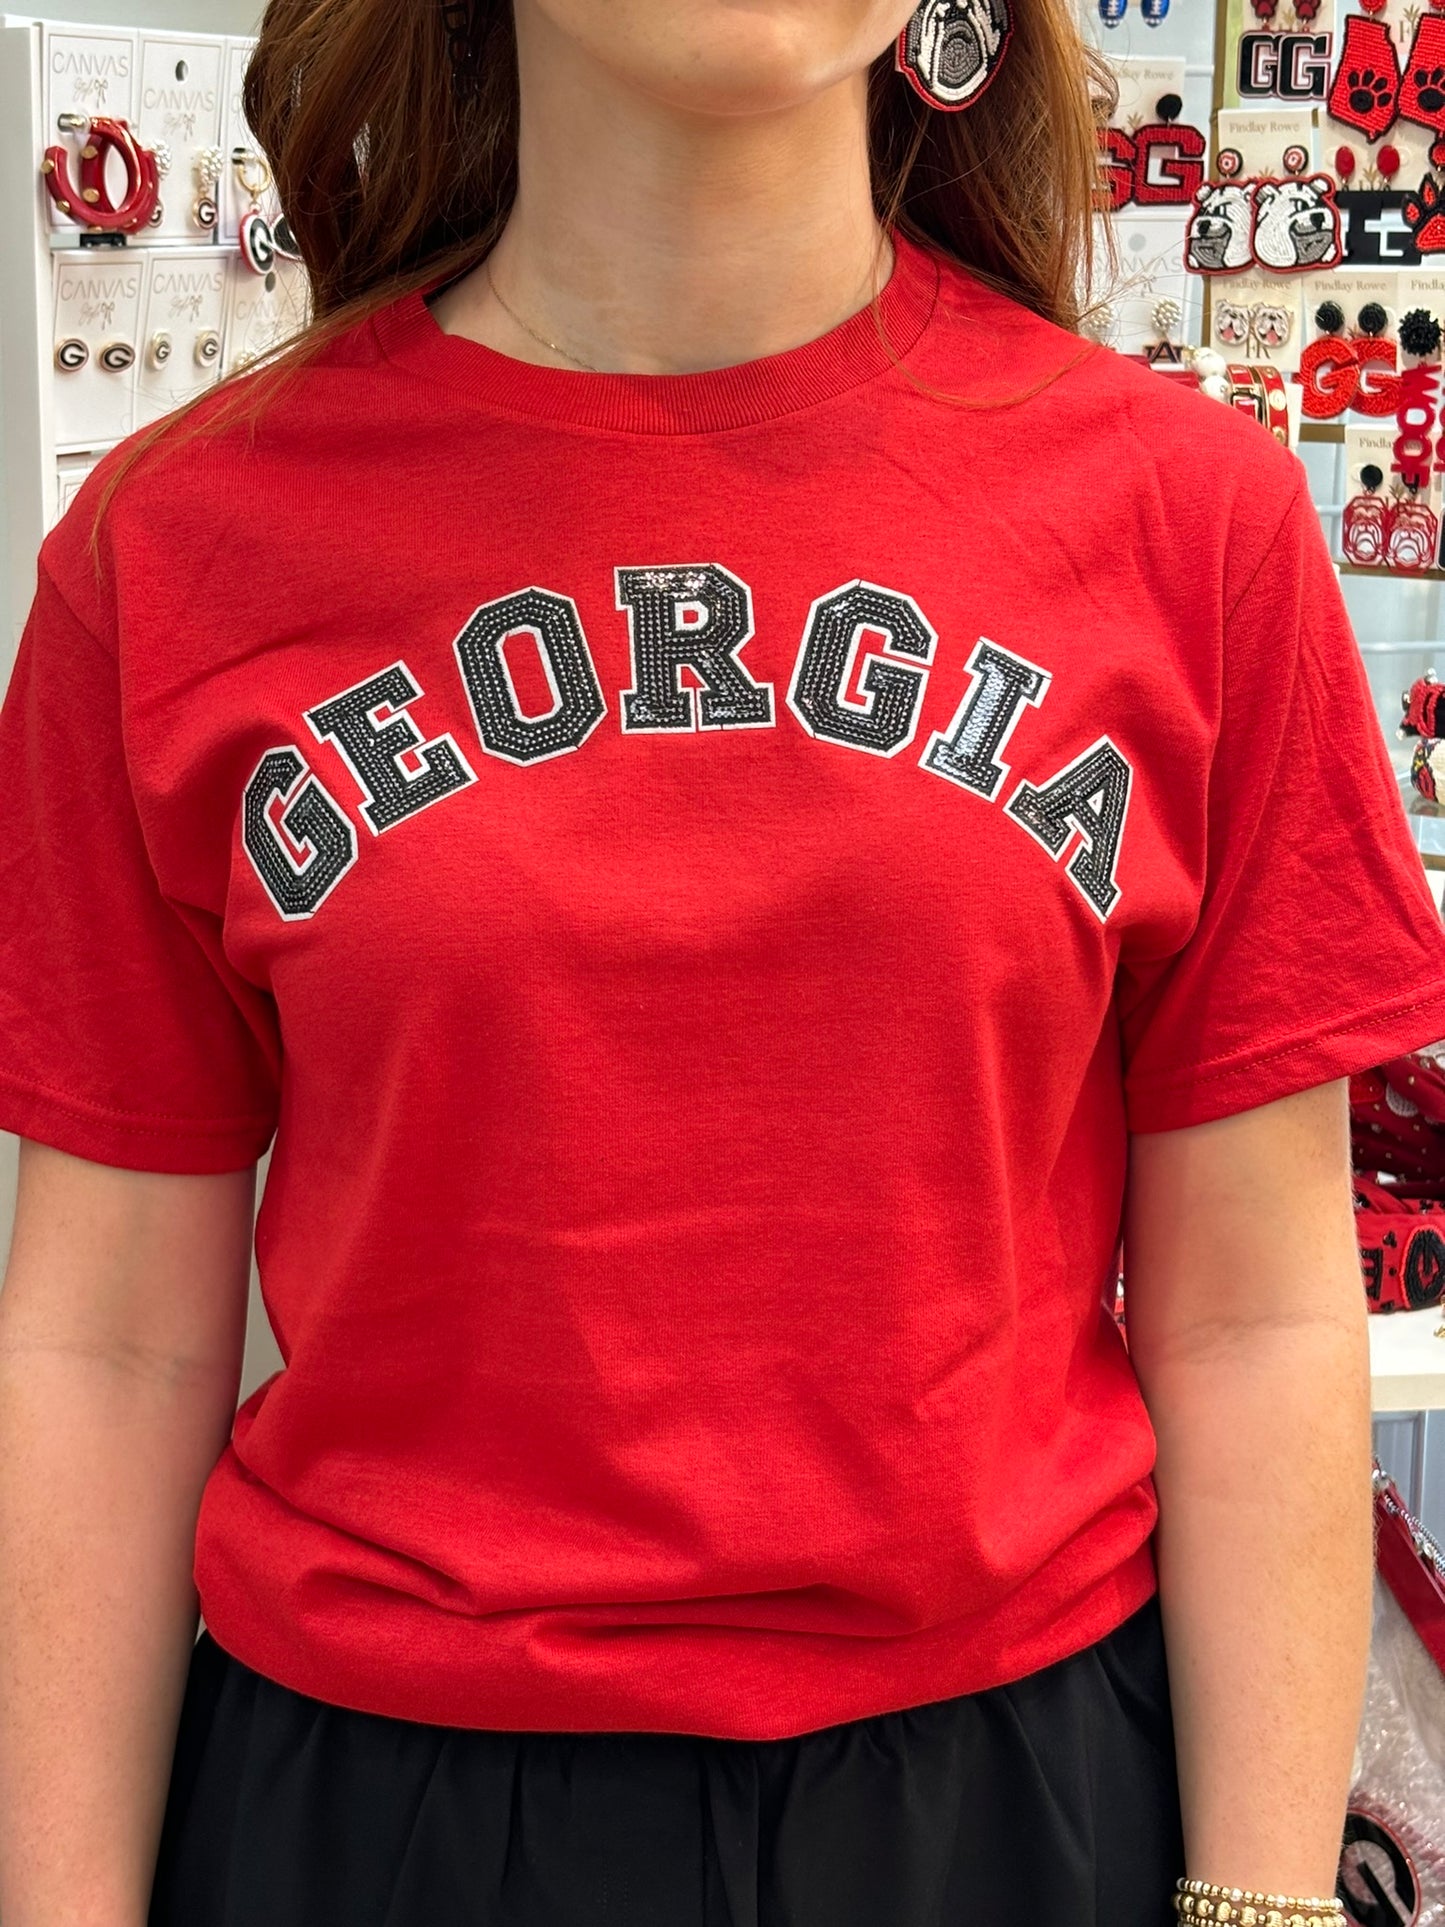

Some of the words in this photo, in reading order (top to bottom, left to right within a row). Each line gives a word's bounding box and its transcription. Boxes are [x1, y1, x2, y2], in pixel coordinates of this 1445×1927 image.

[52, 52, 129, 77] CANVAS
[143, 88, 215, 112] CANVAS
[1229, 122, 1267, 134] Findlay
[1270, 121, 1300, 132] Rowe
[60, 278, 137, 301] CANVAS
[153, 272, 223, 294] CANVAS
[1315, 281, 1355, 292] Findlay
[1357, 281, 1386, 291] Rowe
[1411, 279, 1445, 290] Findla
[59, 342, 87, 369] G
[103, 347, 132, 371] G
[156, 342, 170, 361] G
[202, 340, 217, 357] G
[1359, 438, 1392, 448] Findla
[243, 562, 1135, 921] GEORGIA
